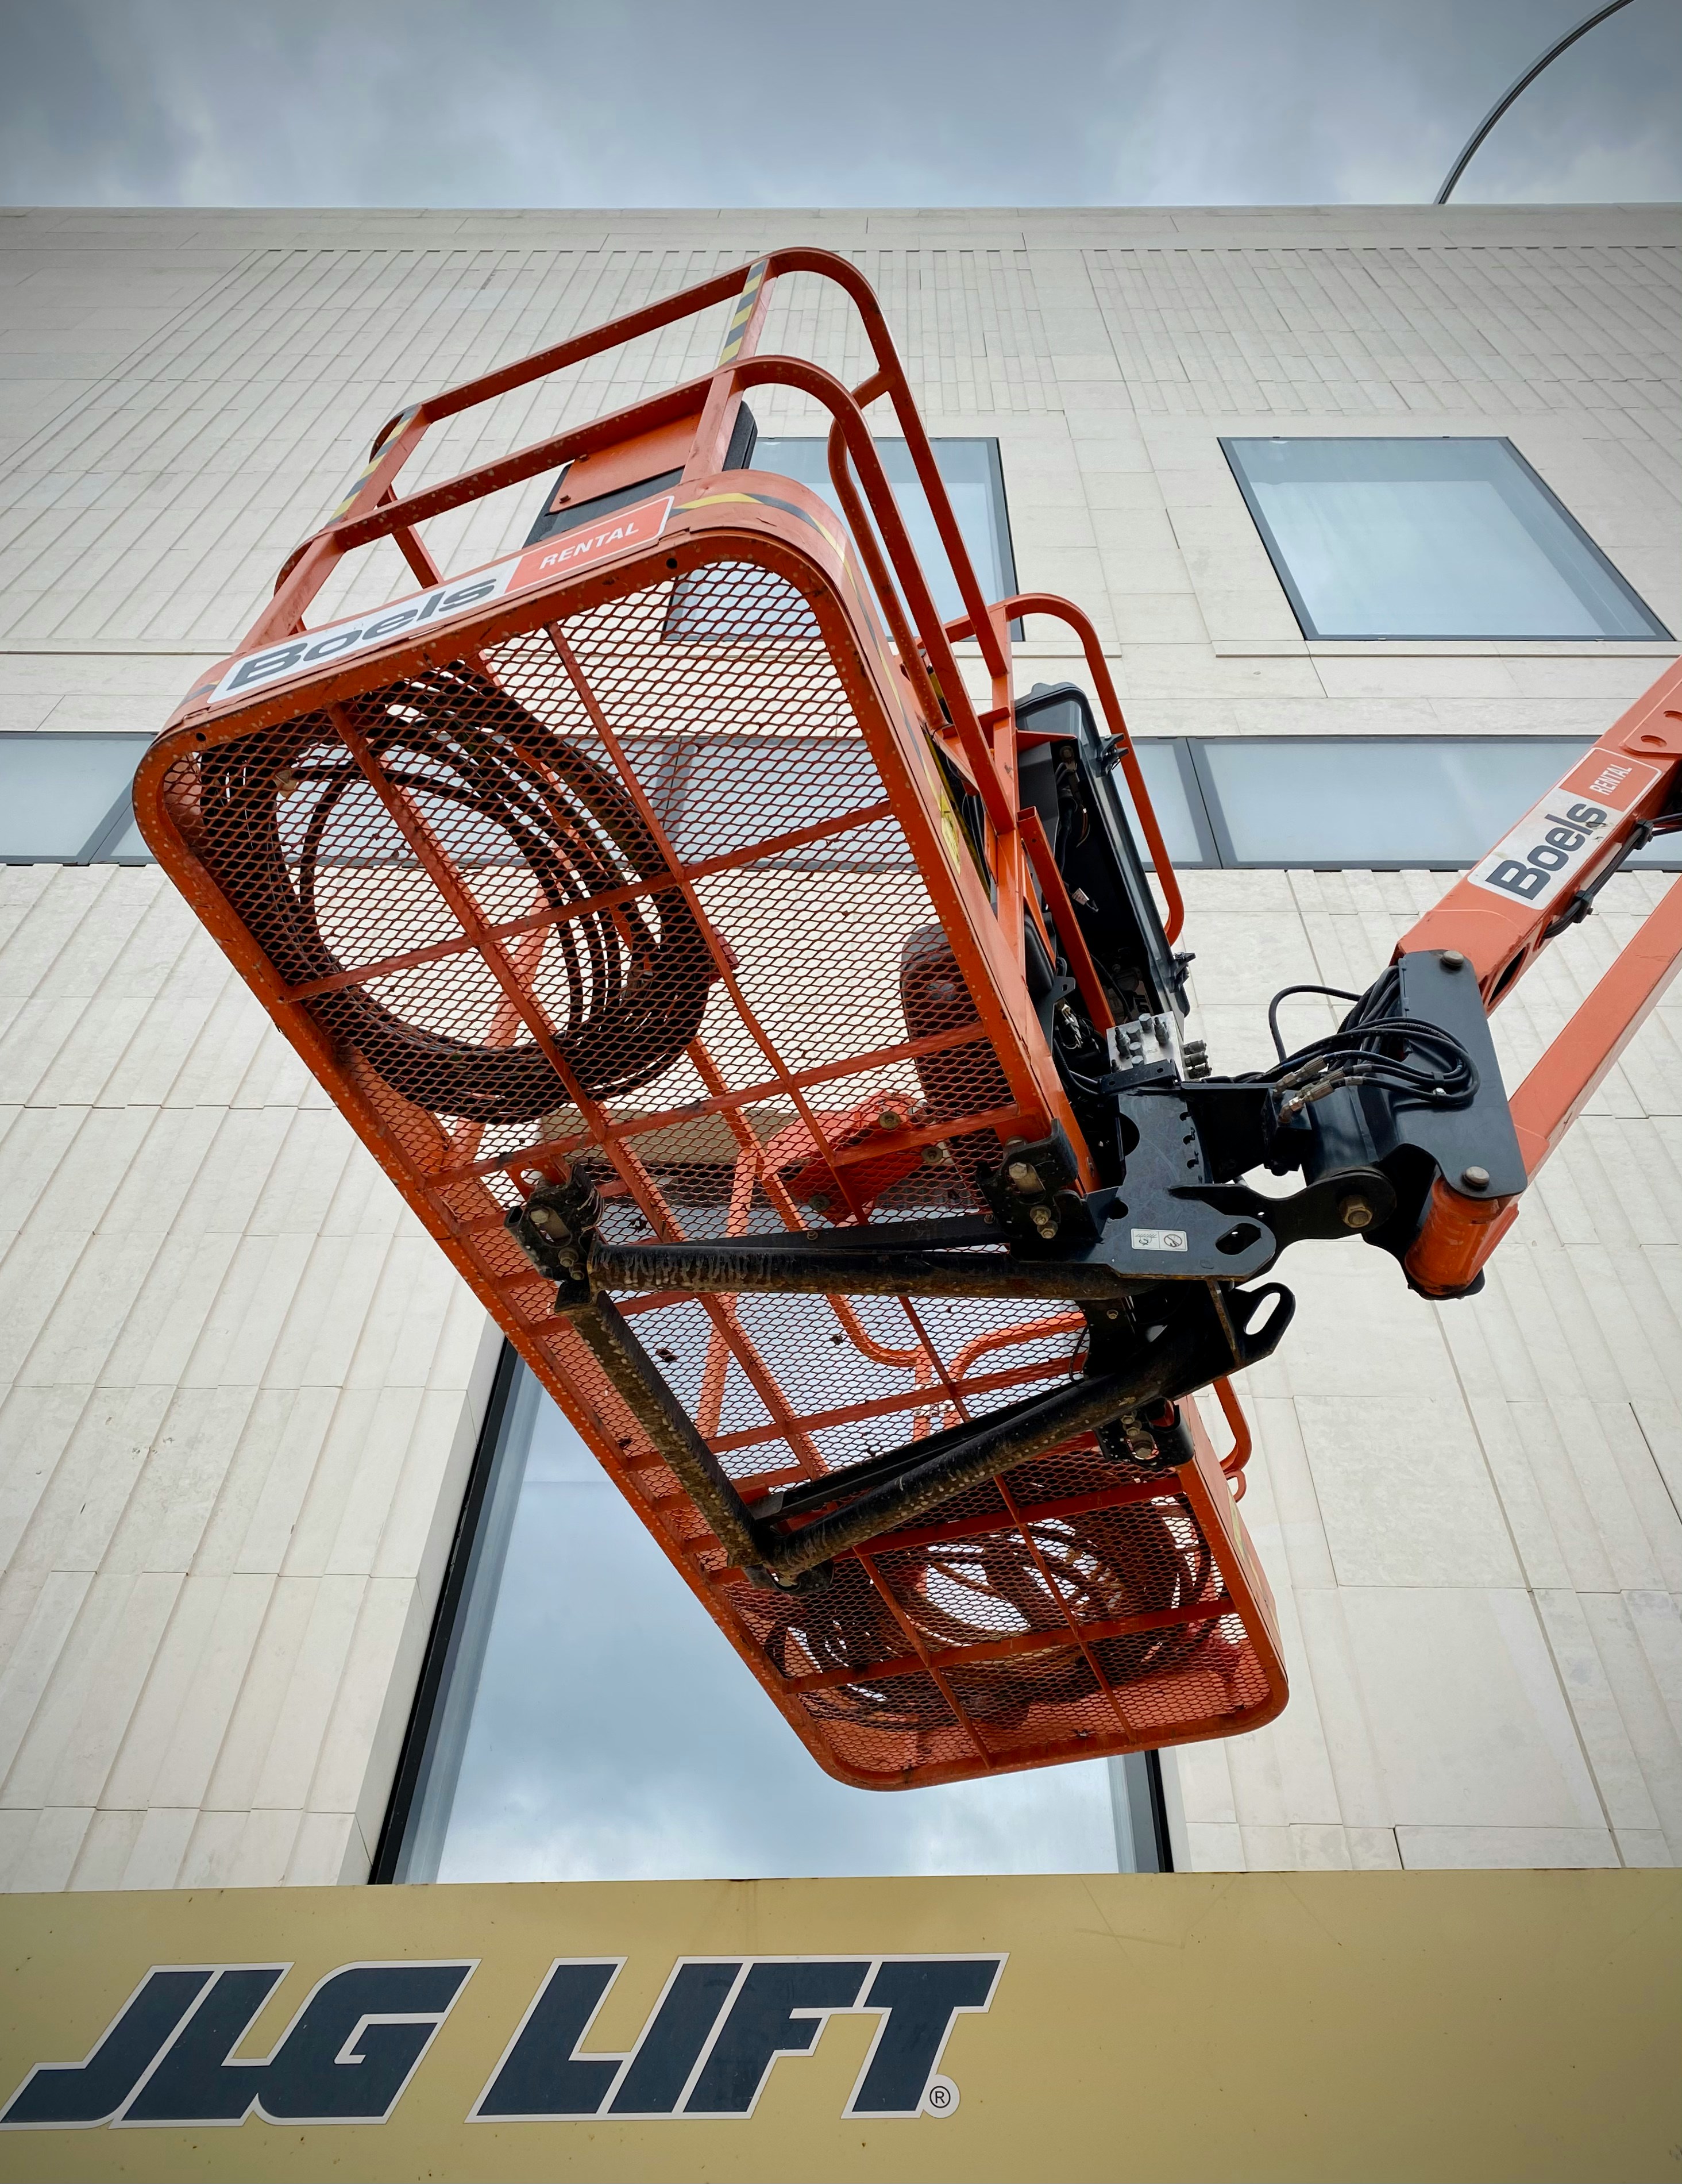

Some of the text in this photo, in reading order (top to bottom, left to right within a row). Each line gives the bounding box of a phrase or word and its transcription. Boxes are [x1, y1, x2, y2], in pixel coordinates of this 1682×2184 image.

[226, 521, 639, 691] Boels RENTAL
[1485, 764, 1633, 900] Boels RENTAL
[0, 1963, 474, 2125] JLG
[473, 1958, 1003, 2118] LIFT
